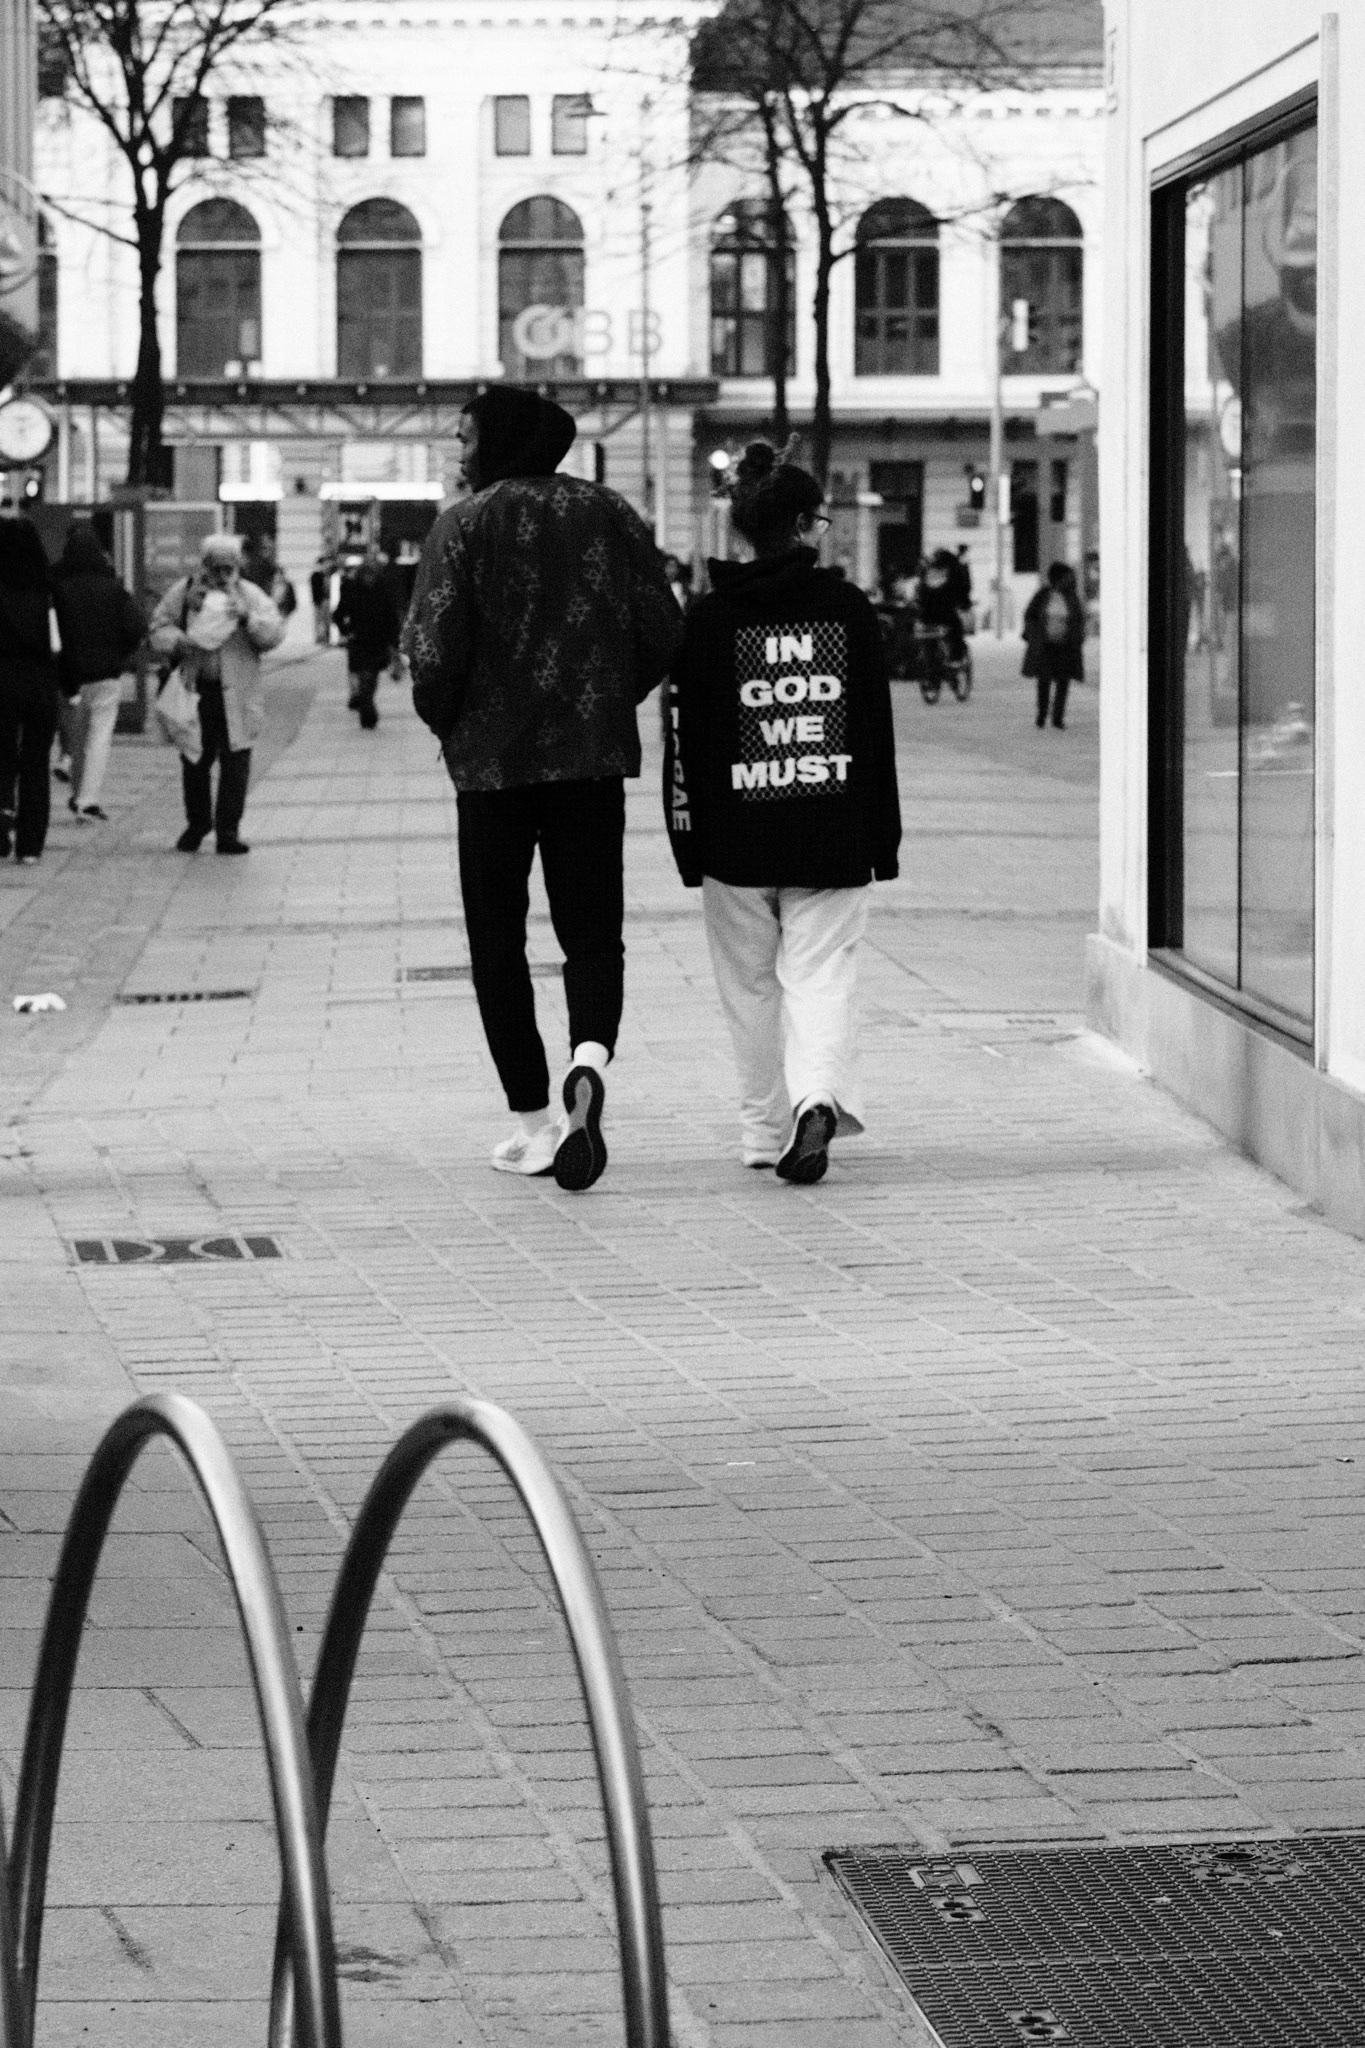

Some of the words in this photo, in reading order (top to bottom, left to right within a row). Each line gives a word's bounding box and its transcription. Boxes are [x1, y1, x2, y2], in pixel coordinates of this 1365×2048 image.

[765, 634, 813, 664] IN
[740, 674, 842, 707] GOD
[759, 715, 825, 746] WE
[731, 754, 853, 790] MUST
